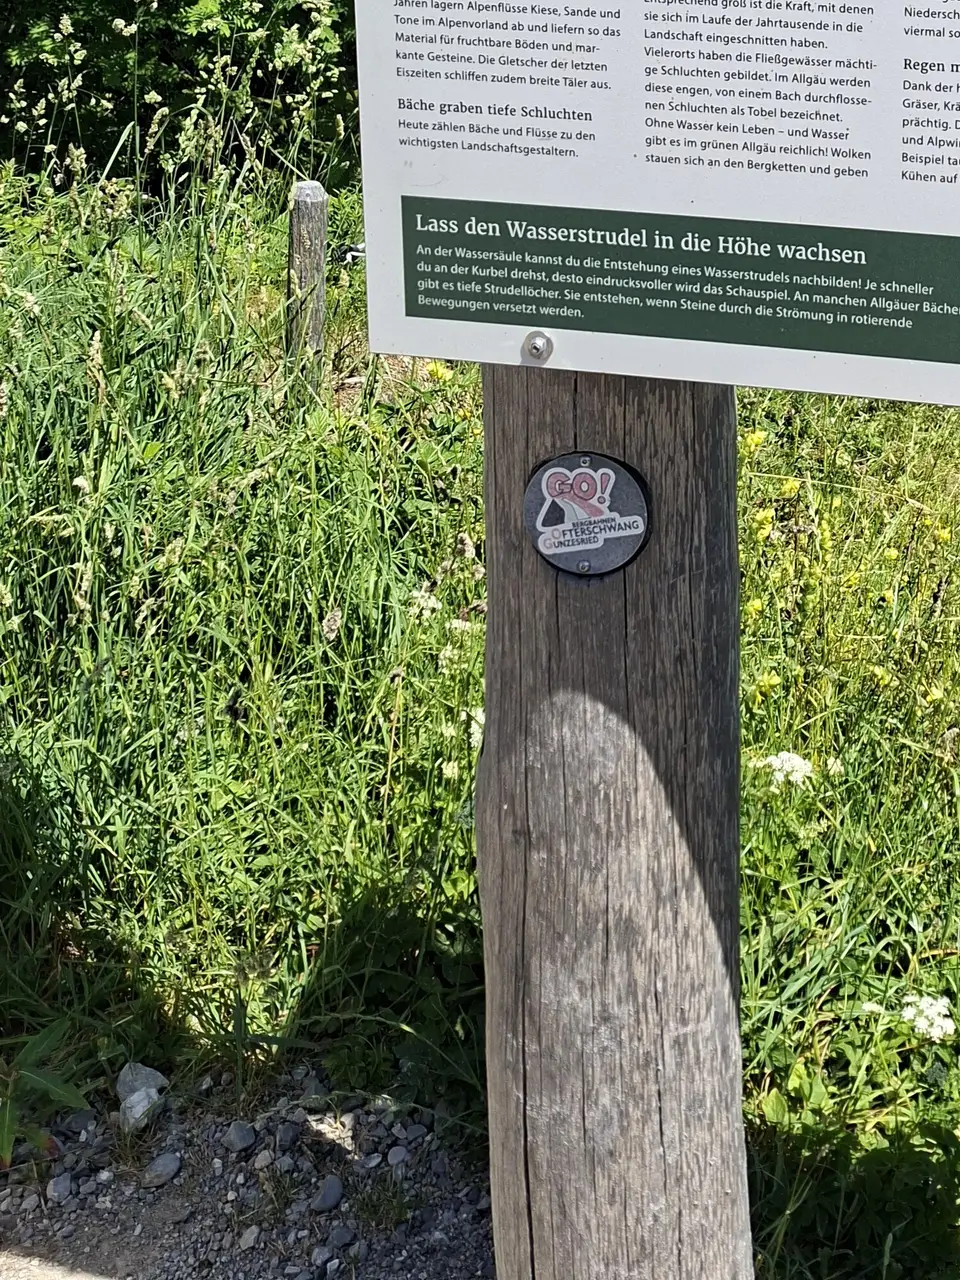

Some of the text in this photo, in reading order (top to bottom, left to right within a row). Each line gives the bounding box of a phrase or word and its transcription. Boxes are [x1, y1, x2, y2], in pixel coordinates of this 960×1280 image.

[466, 0, 528, 14] Alpenflüsse
[530, 4, 561, 17] Kiese,
[563, 5, 597, 18] Sande
[599, 8, 621, 19] und
[903, 25, 945, 37] viermal
[948, 29, 960, 38] so
[903, 58, 945, 75] Regen
[397, 98, 592, 121] Bäche graben tiefe Schluchten
[398, 118, 595, 141] Heute zählen Bäche und Flüsse zu den
[398, 136, 578, 157] wichtigsten Landschaftsgestaltern.
[415, 213, 867, 264] Lass den Wasserstrudel in die Höhe wachsen
[416, 244, 934, 295] An der Wassersäule kannst du die Entstehung eines Wasserstrudels nachbilden! Je schneller
[547, 471, 611, 505] GO!
[551, 520, 640, 540] OFTERSCHWANG
[543, 535, 599, 550] GUNZESRIED
